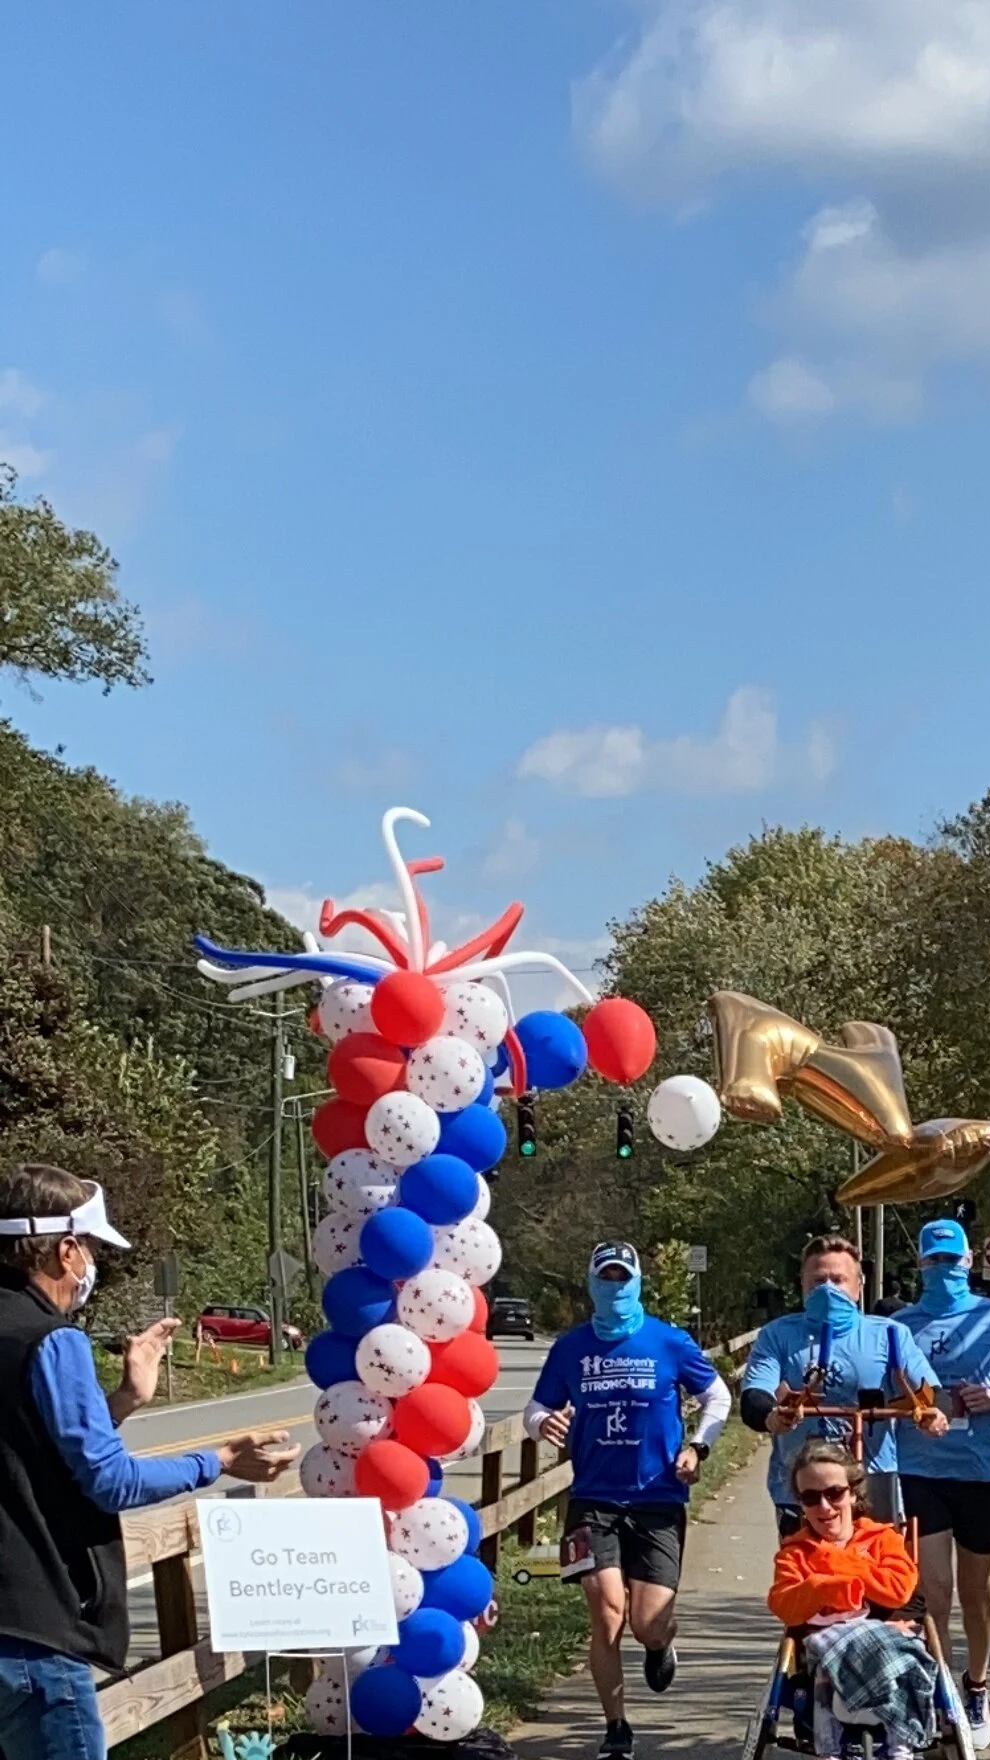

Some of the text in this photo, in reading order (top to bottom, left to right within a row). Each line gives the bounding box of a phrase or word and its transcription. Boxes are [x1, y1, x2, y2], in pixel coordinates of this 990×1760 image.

[250, 1548, 337, 1566] Go Team
[229, 1577, 371, 1600] Bentley-Grace
